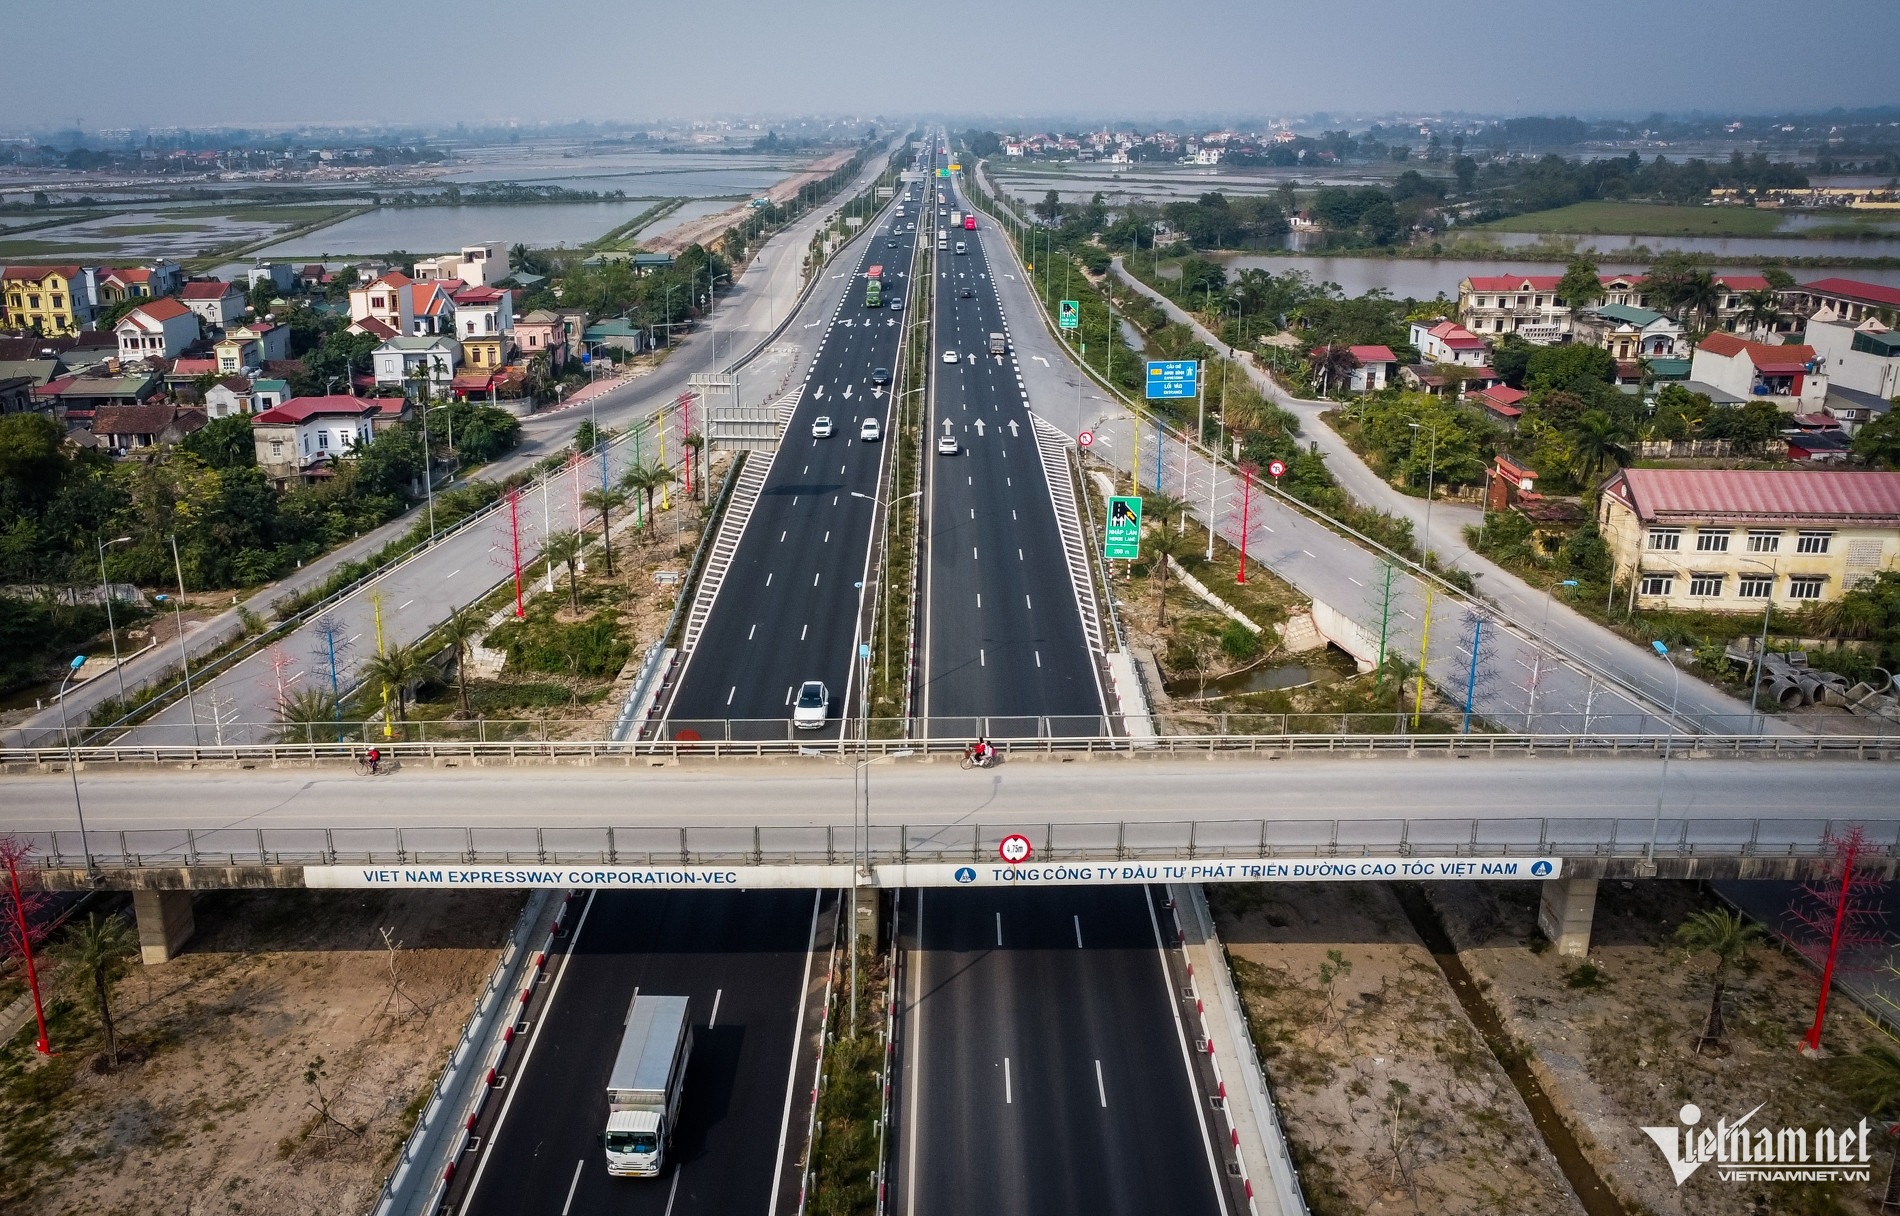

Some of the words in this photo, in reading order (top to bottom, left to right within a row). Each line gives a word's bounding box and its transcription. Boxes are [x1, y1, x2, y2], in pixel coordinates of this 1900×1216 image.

[363, 870, 400, 882] VIET
[406, 870, 442, 882] NAM
[448, 871, 562, 883] EXPRESSWAY
[569, 872, 736, 884] CORPORATION-VEC
[992, 866, 1040, 880] TỔNG
[1044, 866, 1092, 880] CÔNG
[1098, 868, 1118, 880] TY
[1122, 864, 1157, 879] ĐẦU
[1163, 866, 1186, 878] TƯ
[1191, 863, 1236, 878] PHÁT
[1241, 862, 1288, 877] TRIỂN
[1293, 862, 1356, 876] ĐƯỜNG
[1361, 863, 1396, 876] CAO
[1402, 860, 1434, 875] TỐC
[1440, 860, 1476, 878] VIỆT
[1480, 863, 1518, 875] NAM
